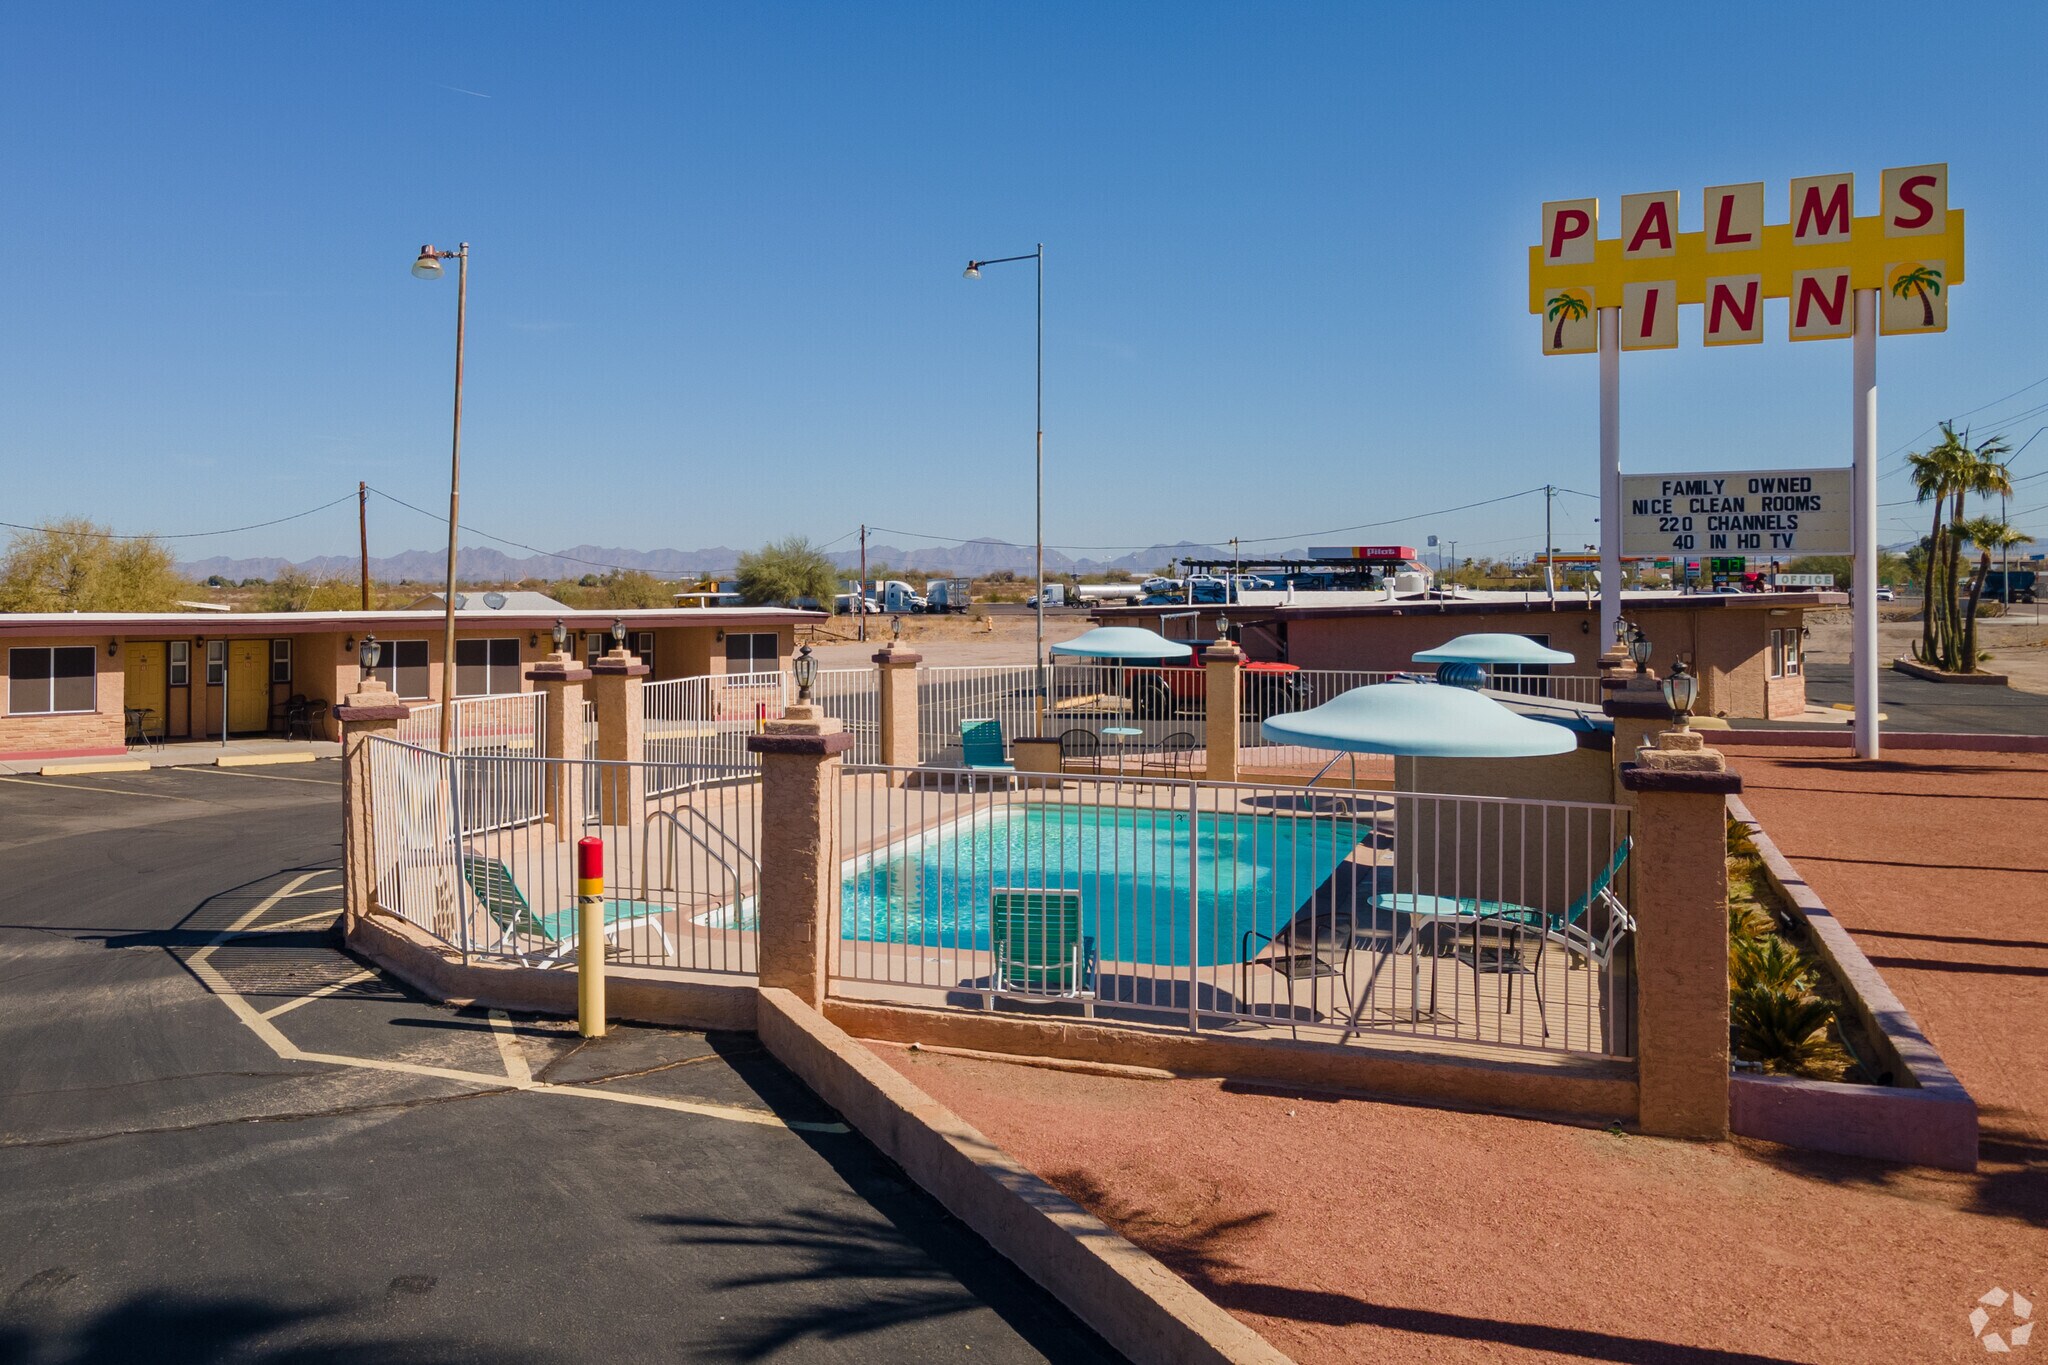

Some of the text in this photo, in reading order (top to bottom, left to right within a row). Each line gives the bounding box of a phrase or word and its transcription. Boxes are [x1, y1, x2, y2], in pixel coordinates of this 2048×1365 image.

[1550, 175, 1937, 258] PALMS
[1640, 274, 1849, 337] INN
[1662, 477, 1812, 496] FAMILY OWNED
[1632, 495, 1821, 515] NICE CLEAN ROOMS
[1659, 514, 1798, 532] 220 CHANNELS
[1672, 533, 1793, 550] 40 IN HD TV
[1781, 575, 1832, 585] OFFICE
